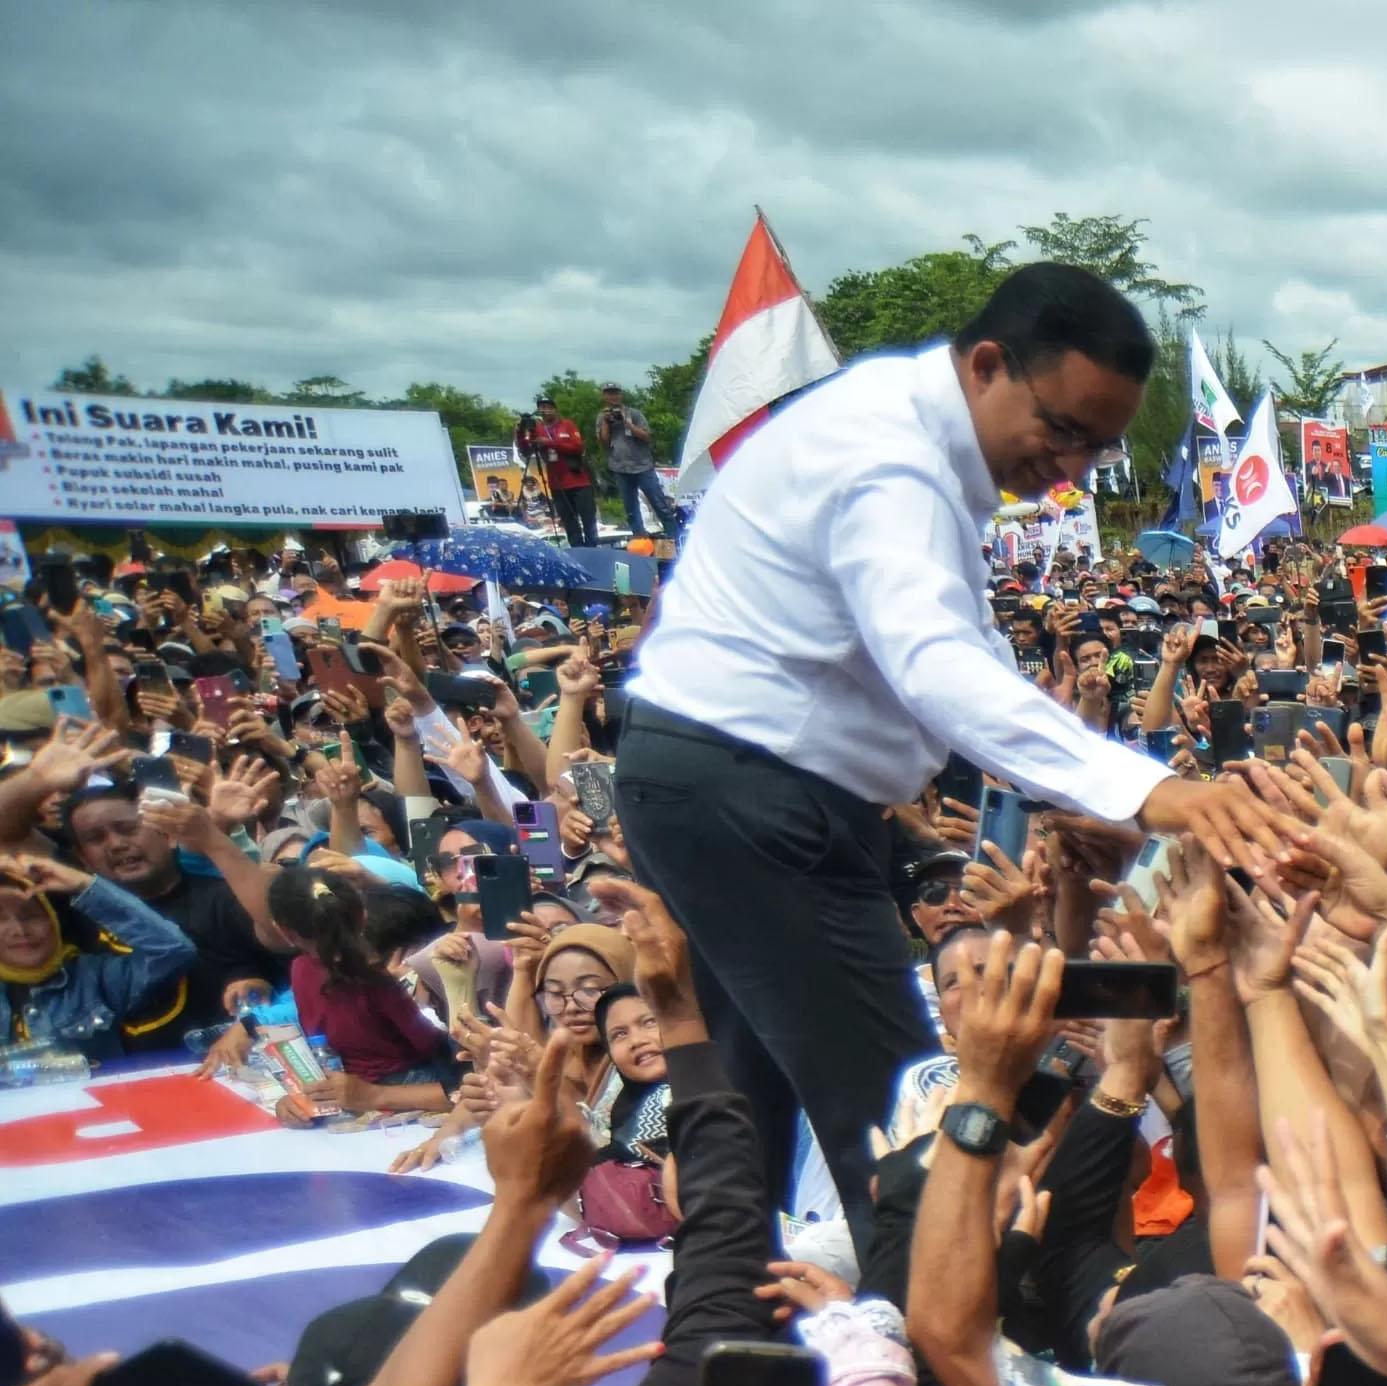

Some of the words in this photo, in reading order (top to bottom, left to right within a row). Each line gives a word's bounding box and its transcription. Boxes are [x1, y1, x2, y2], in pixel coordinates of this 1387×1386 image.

[21, 399, 81, 427] Ini
[87, 404, 207, 435] Suara
[213, 411, 318, 439] Kami!
[144, 437, 217, 452] lapangan
[221, 442, 296, 455] pekerjaan
[298, 444, 365, 458] sekarang
[367, 447, 398, 458] sulit
[104, 451, 154, 464] makin
[156, 453, 189, 466] hari
[192, 455, 239, 468] makin
[241, 458, 291, 470] mahal,
[292, 461, 342, 473] pusing
[344, 461, 377, 472] kami
[380, 463, 404, 474] pak
[476, 451, 508, 462] ANIES
[113, 468, 172, 480] subsidi
[175, 471, 222, 482] susah
[111, 483, 174, 496] sekolah
[177, 487, 224, 498] mahal
[115, 500, 155, 511] solar
[159, 501, 207, 513] mahal
[208, 503, 260, 517] langka
[263, 505, 299, 517] pula,
[301, 507, 327, 516] nak
[330, 506, 357, 516] cari
